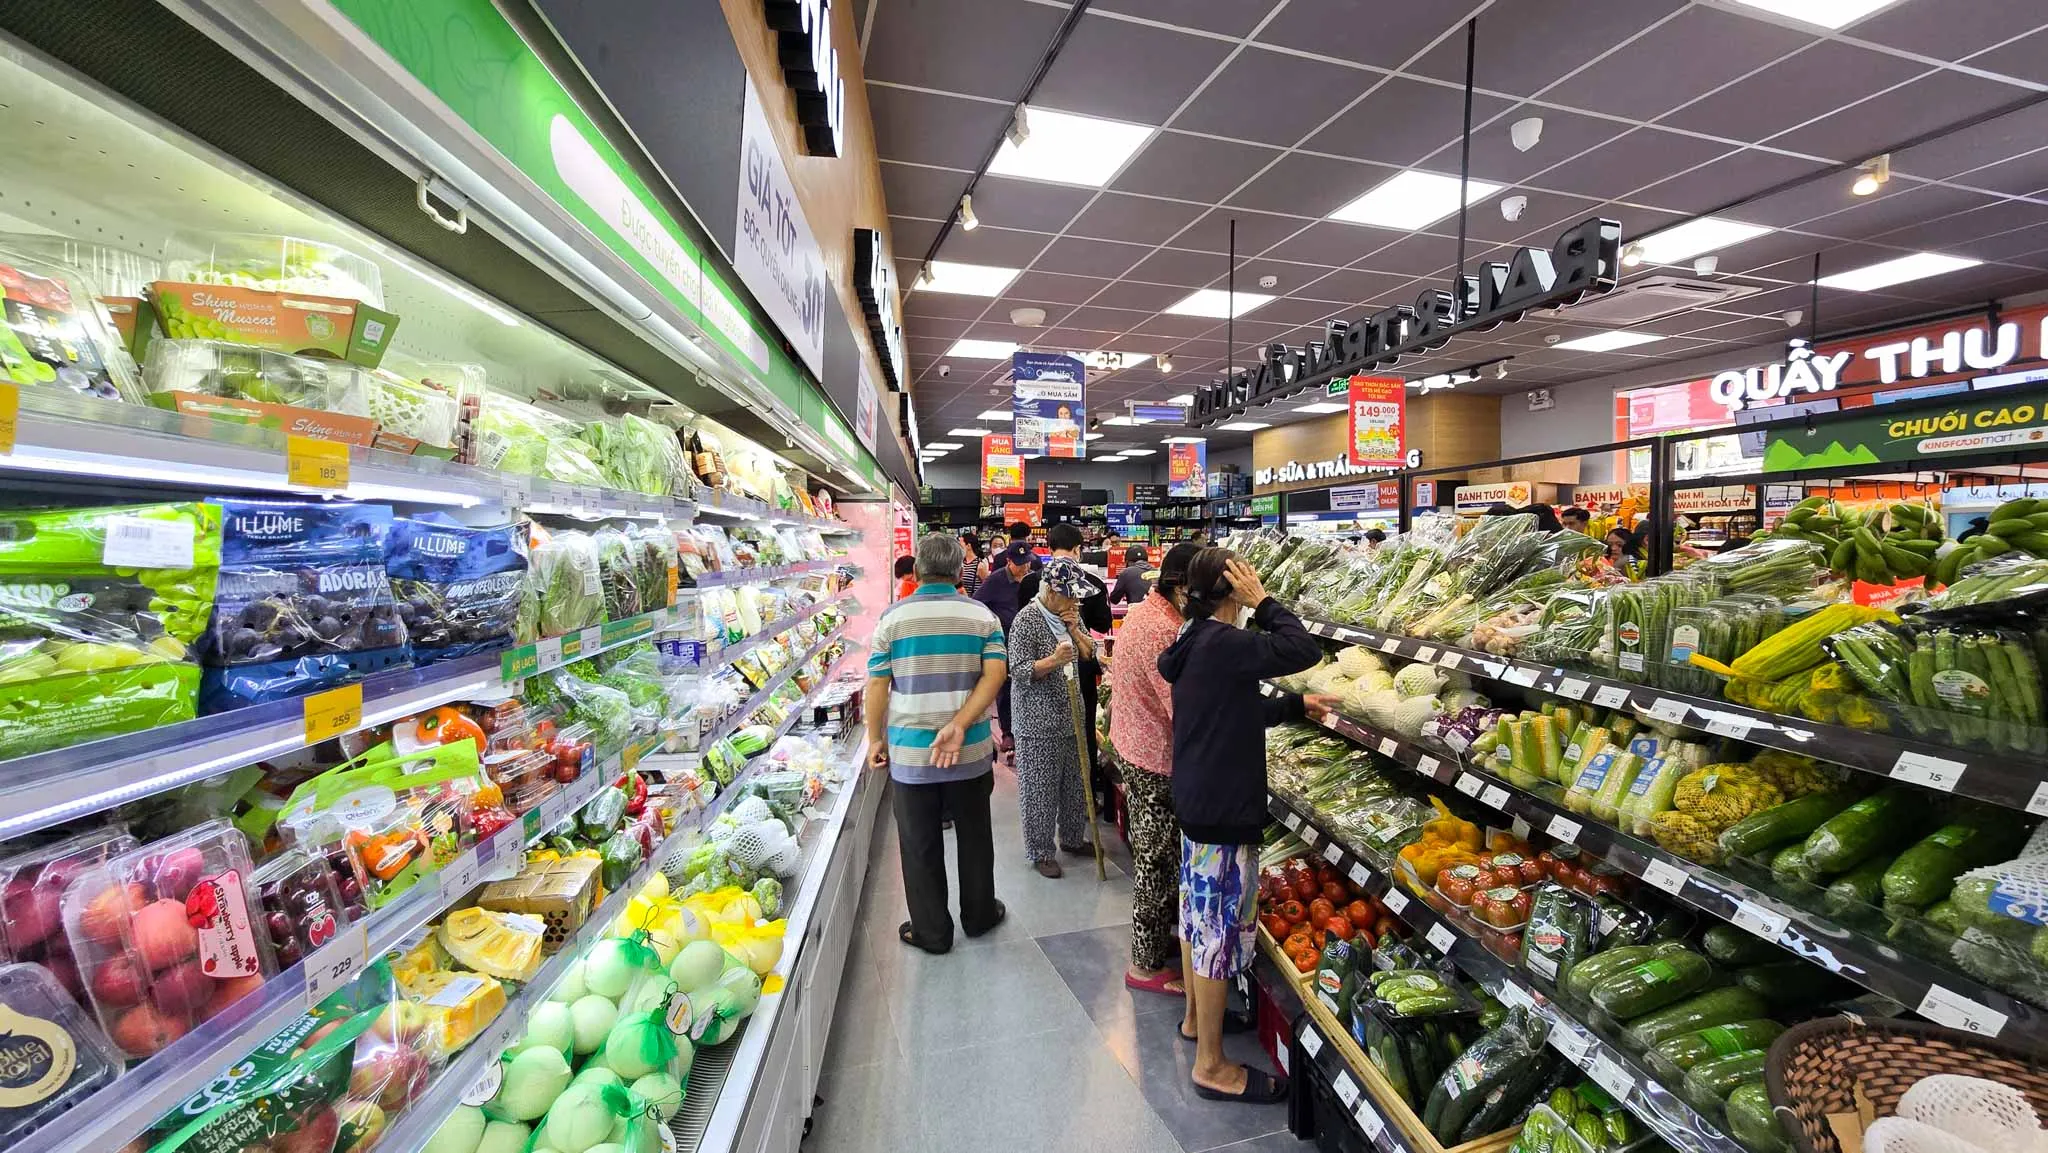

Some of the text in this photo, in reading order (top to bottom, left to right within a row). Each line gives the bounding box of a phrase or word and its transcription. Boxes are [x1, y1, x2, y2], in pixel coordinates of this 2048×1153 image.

[747, 136, 797, 267] GIÁ TỐT
[743, 207, 760, 249] ĐỘC
[191, 292, 237, 310] Shine
[214, 307, 276, 327] Muscat
[1710, 338, 1851, 411] QUẦY
[1864, 322, 2018, 384] THU
[291, 418, 333, 435] Shine
[1888, 408, 1967, 438] CHUỐI
[1974, 405, 2036, 428] CAO
[991, 437, 1009, 445] MUA
[319, 467, 336, 479] 189
[1256, 466, 1275, 485] BƠ
[1278, 461, 1306, 483] SỮA
[1381, 487, 1398, 495] MUA
[235, 515, 304, 535] ILLUME
[413, 536, 465, 554] ILLUME
[332, 712, 351, 728] 259
[1730, 725, 1741, 734] 17
[1928, 771, 1943, 782] 15
[1562, 830, 1571, 838] 20
[461, 872, 470, 885] 21
[1663, 877, 1674, 887] 39
[214, 886, 243, 970] Strawberry apple
[1760, 923, 1772, 933] 19
[331, 957, 352, 979] 229
[1962, 1017, 1981, 1031] 16
